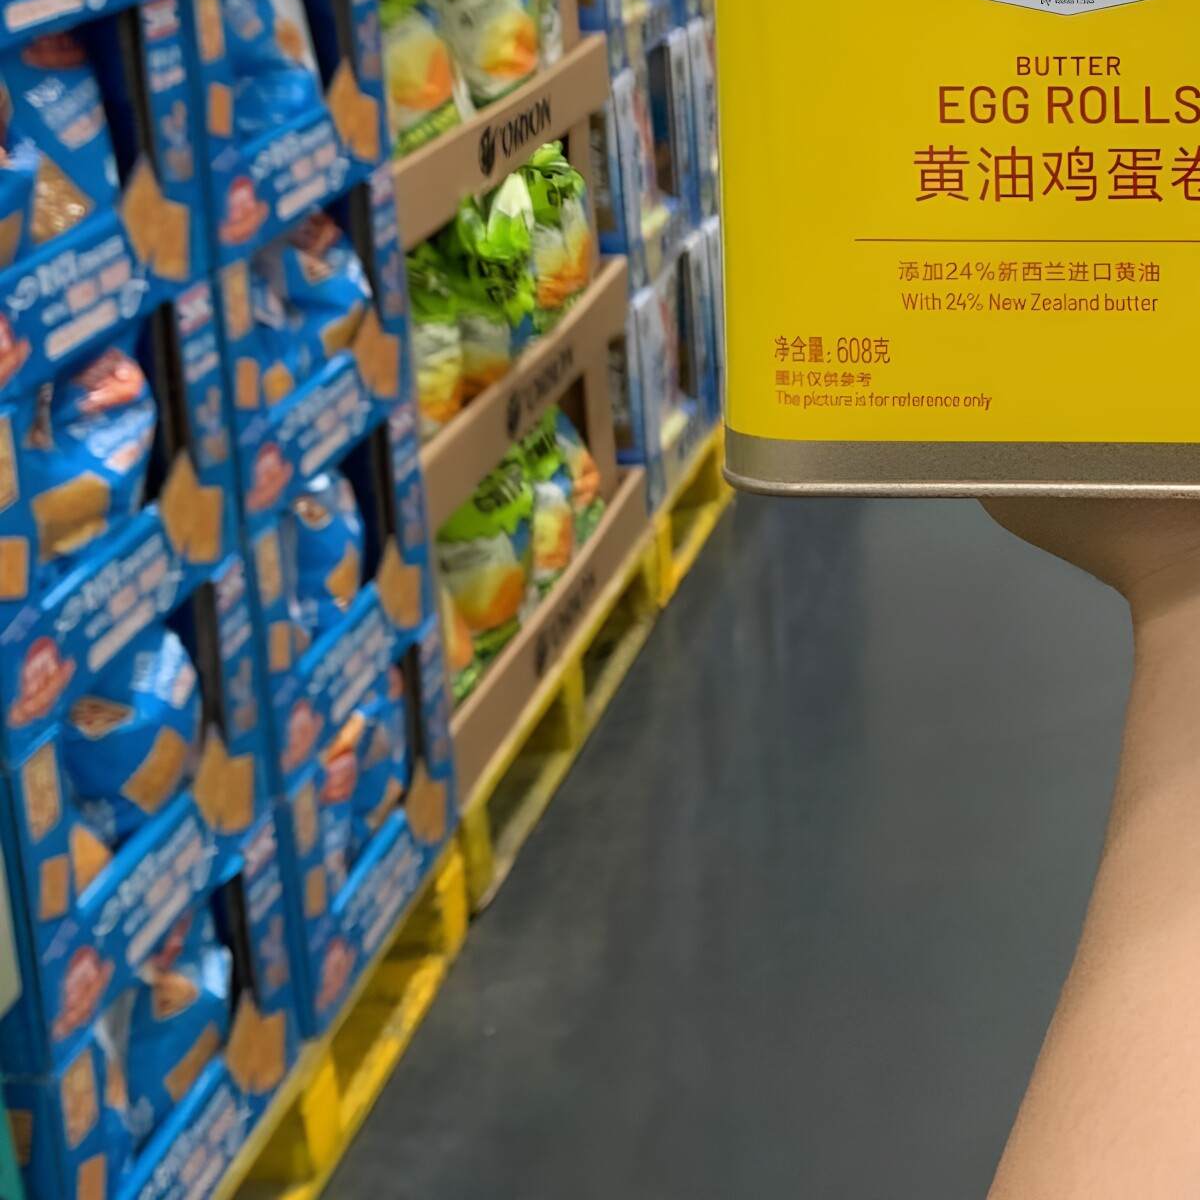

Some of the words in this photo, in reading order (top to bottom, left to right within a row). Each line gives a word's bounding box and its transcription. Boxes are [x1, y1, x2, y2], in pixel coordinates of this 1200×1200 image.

[1016, 56, 1121, 76] BUTTER
[938, 86, 1030, 125] EGG
[898, 260, 1160, 283] 添加24%新西兰进口黄油
[901, 292, 942, 311] With
[946, 292, 984, 311] 24%
[989, 293, 1027, 311] New
[1030, 293, 1100, 311] Zealand
[1104, 293, 1159, 312] butter
[776, 390, 801, 406] The
[804, 391, 853, 410] picture
[855, 392, 867, 407] is
[868, 392, 890, 407] for
[963, 392, 993, 411] only
